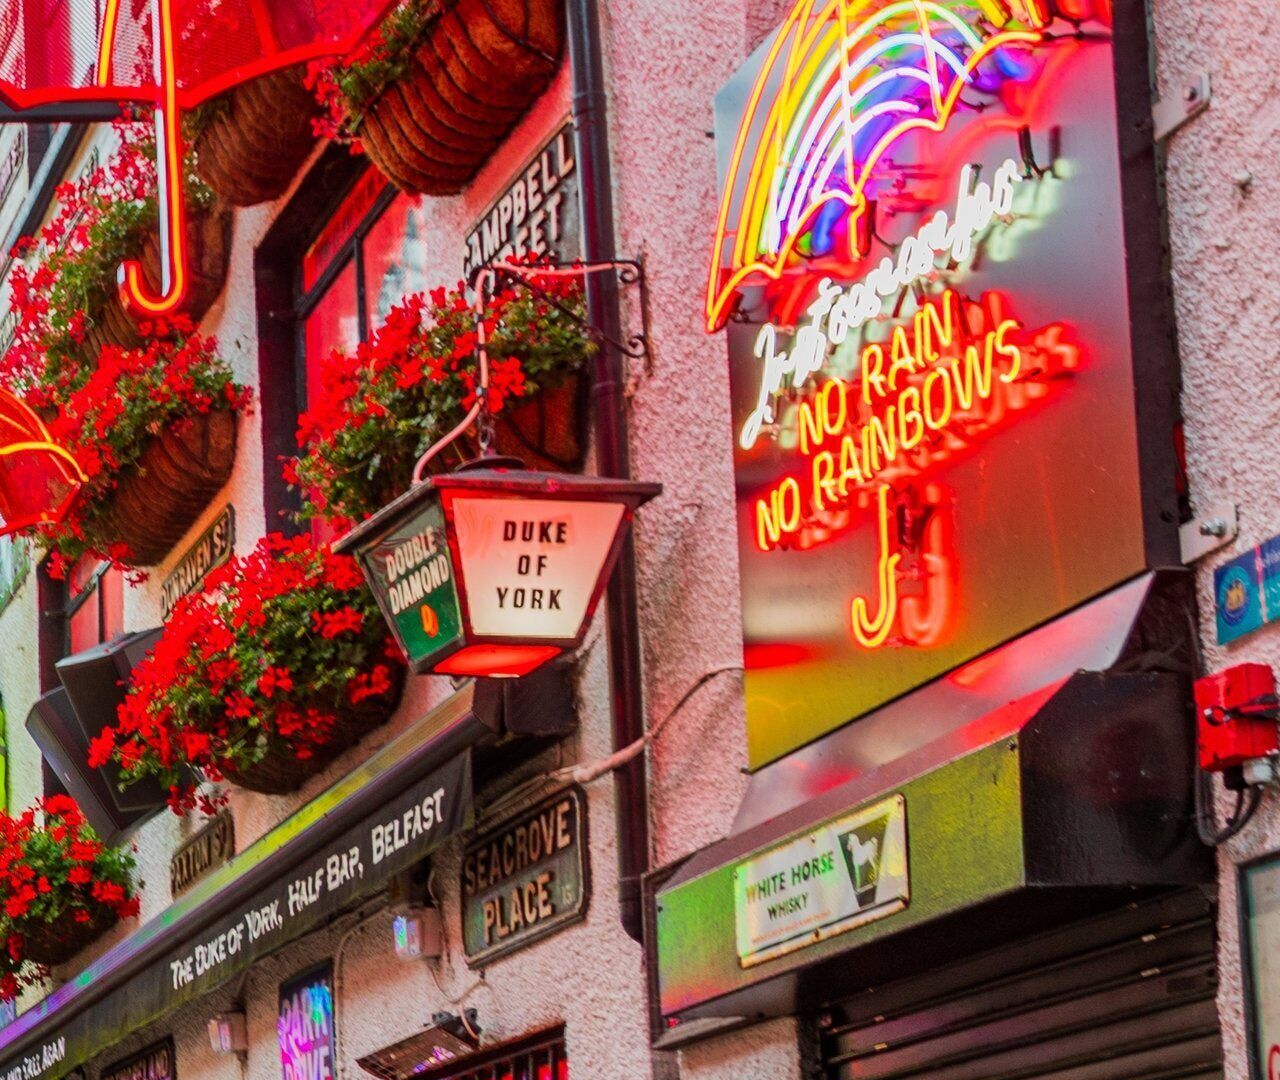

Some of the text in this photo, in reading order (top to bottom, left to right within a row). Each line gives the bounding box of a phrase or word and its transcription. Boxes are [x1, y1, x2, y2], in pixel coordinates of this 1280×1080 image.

[798, 289, 954, 456] NO RAIN
[755, 319, 1022, 552] NO RAINBOWS
[385, 525, 438, 582] DOUBLE
[503, 520, 568, 543] DUKE
[388, 553, 450, 616] DIAMOND
[517, 555, 548, 576] OF
[496, 587, 563, 610] YORK
[170, 787, 446, 990] THE DUKE OF YORK, HALF BAP, BELFAST
[746, 848, 835, 905] WHITE HORSE
[481, 871, 552, 947] PLACE
[767, 891, 809, 920] WHISKY
